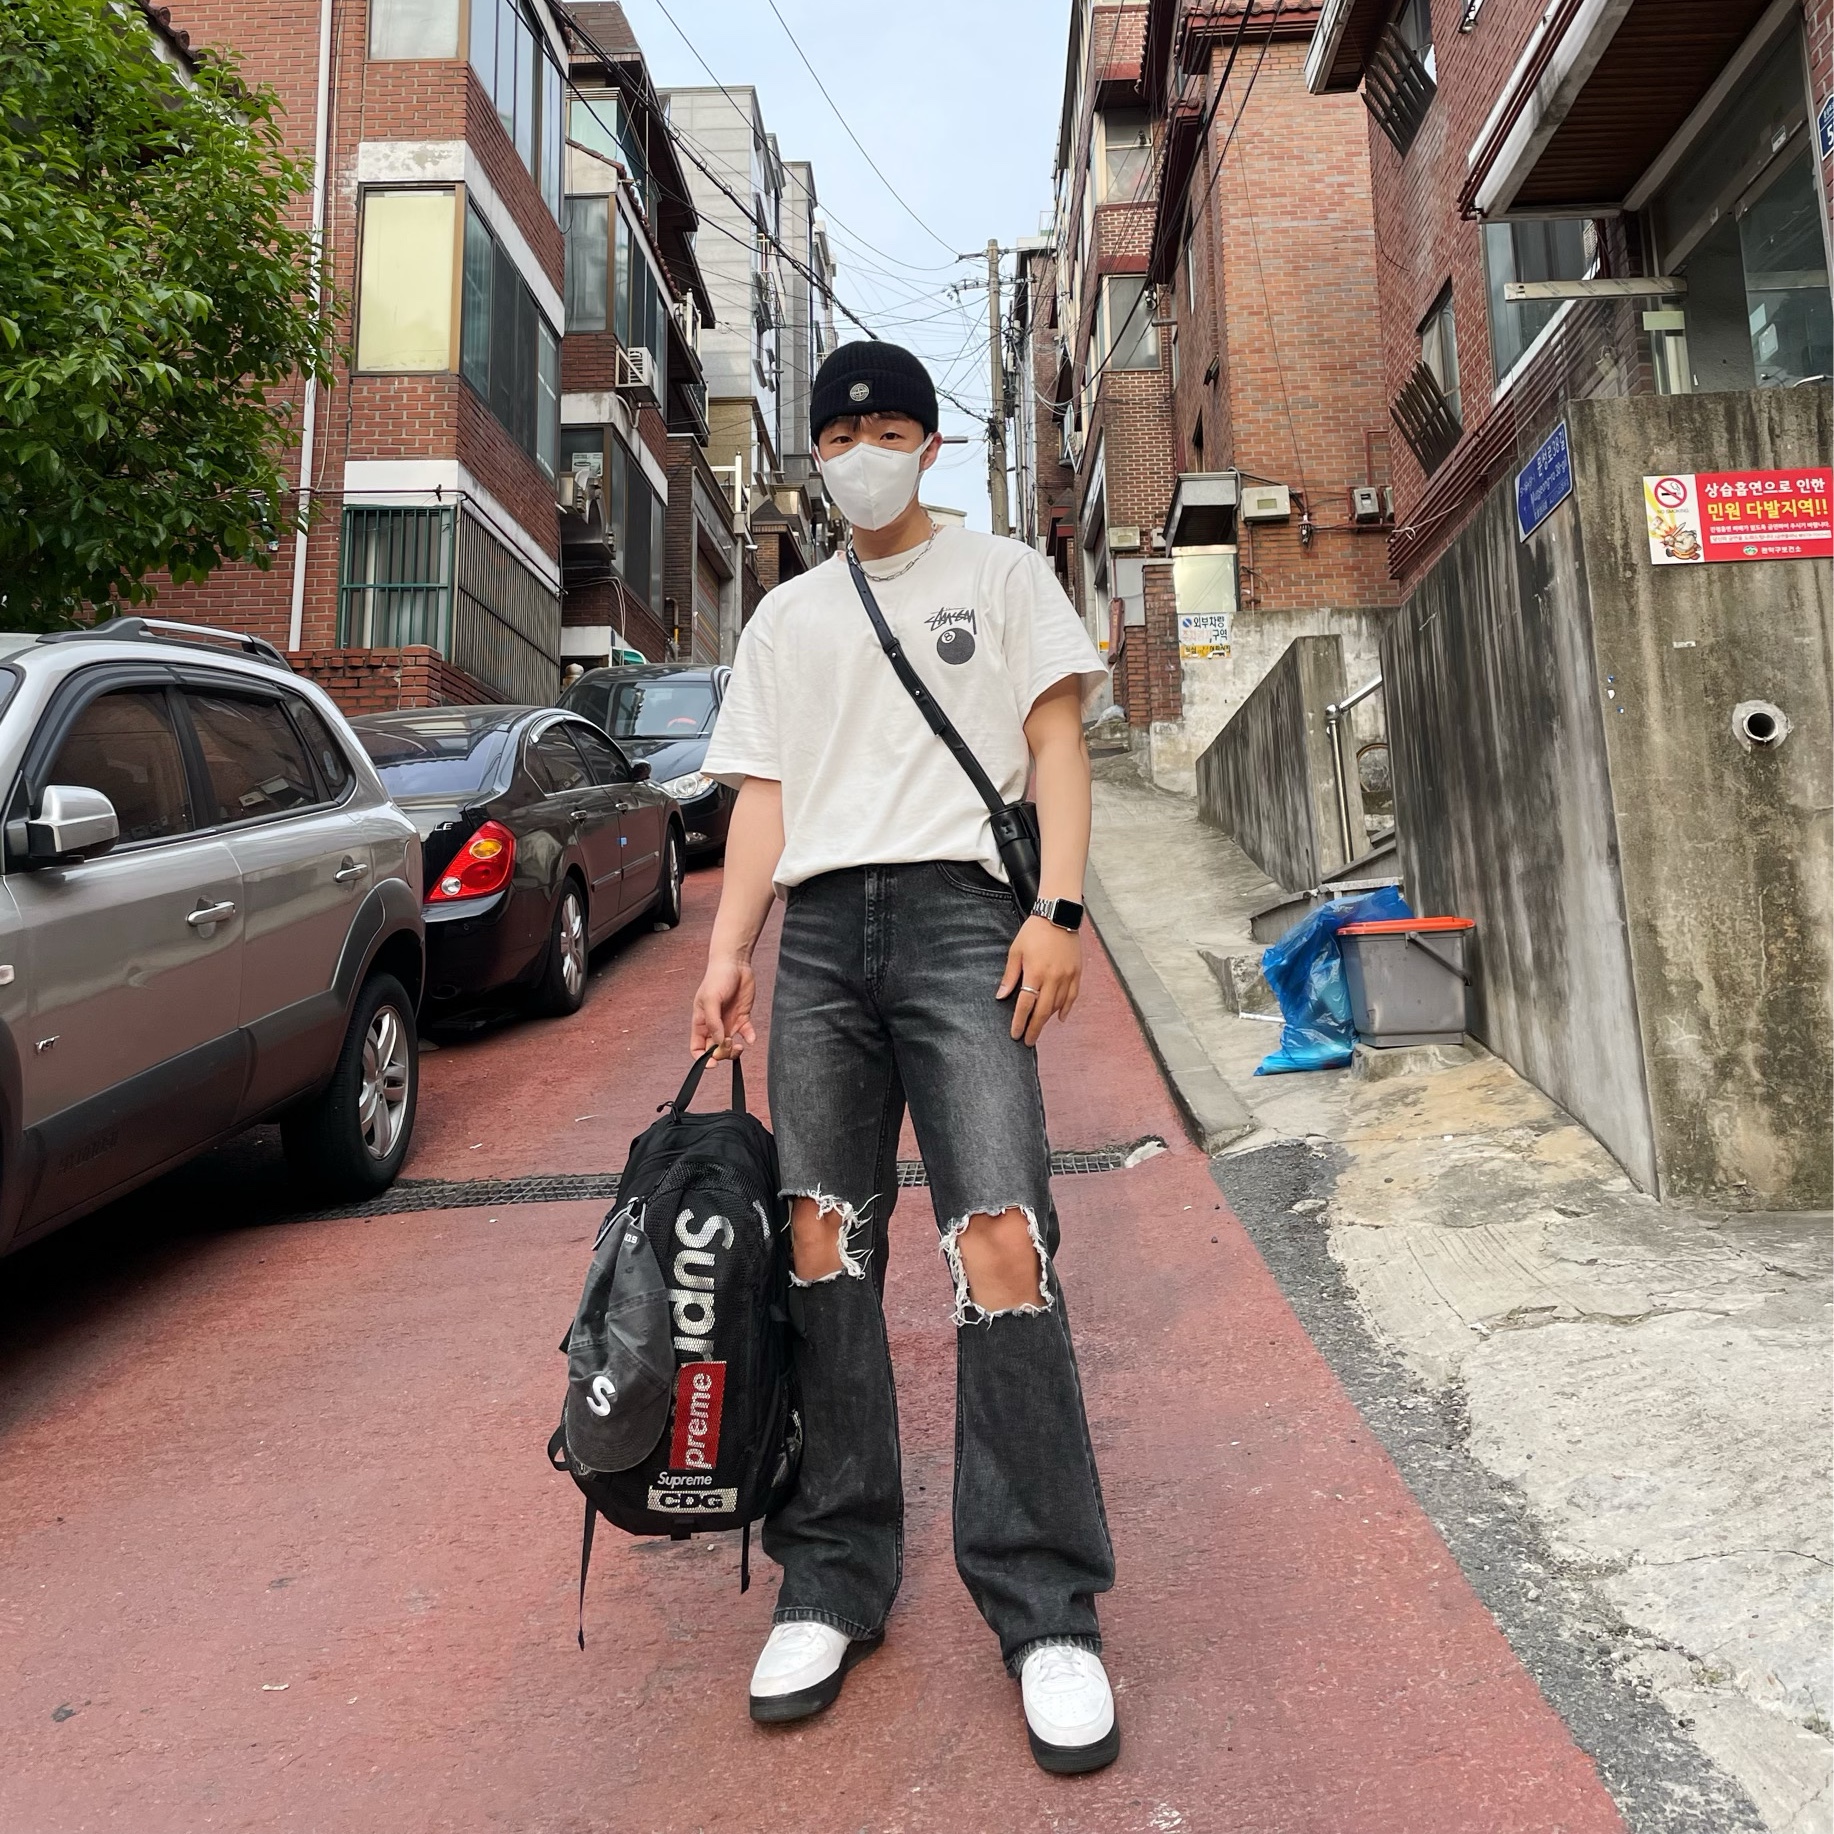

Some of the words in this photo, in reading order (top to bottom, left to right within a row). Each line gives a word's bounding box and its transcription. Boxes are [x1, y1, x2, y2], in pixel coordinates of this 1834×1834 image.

[1704, 480, 1793, 498] 상습흡연으로
[1796, 478, 1825, 494] 인한
[1707, 501, 1741, 521] 민원
[1746, 498, 1829, 519] 다발지역!!
[1194, 616, 1225, 629] 외부차량
[943, 632, 953, 641] 8
[586, 1375, 617, 1417] S
[685, 1372, 713, 1469] preme
[657, 1471, 713, 1489] Supreme
[659, 1493, 724, 1508] CDG
